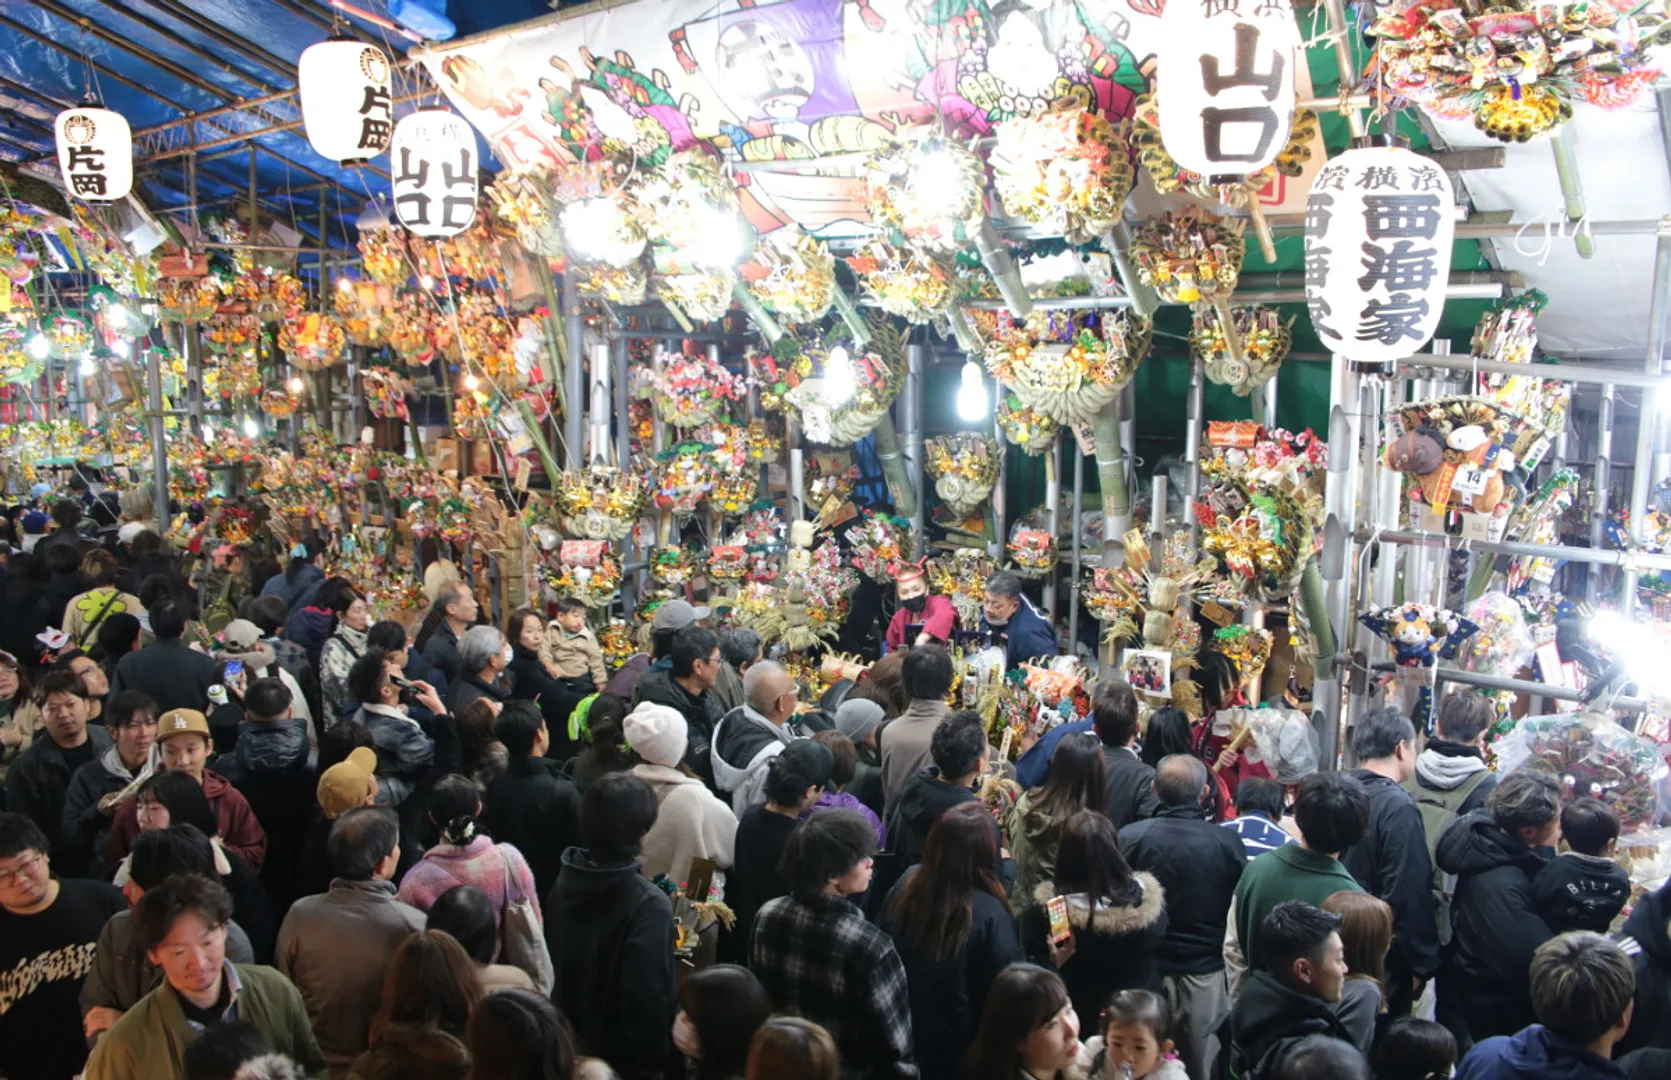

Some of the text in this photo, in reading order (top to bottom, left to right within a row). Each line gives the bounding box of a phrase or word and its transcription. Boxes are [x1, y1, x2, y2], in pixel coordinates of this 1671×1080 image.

[357, 85, 392, 151] 片岡
[1199, 22, 1286, 163] 山口
[67, 145, 107, 196] 片岡
[1355, 193, 1441, 346] 西海家
[1467, 470, 1481, 485] 14
[173, 713, 187, 729] LA
